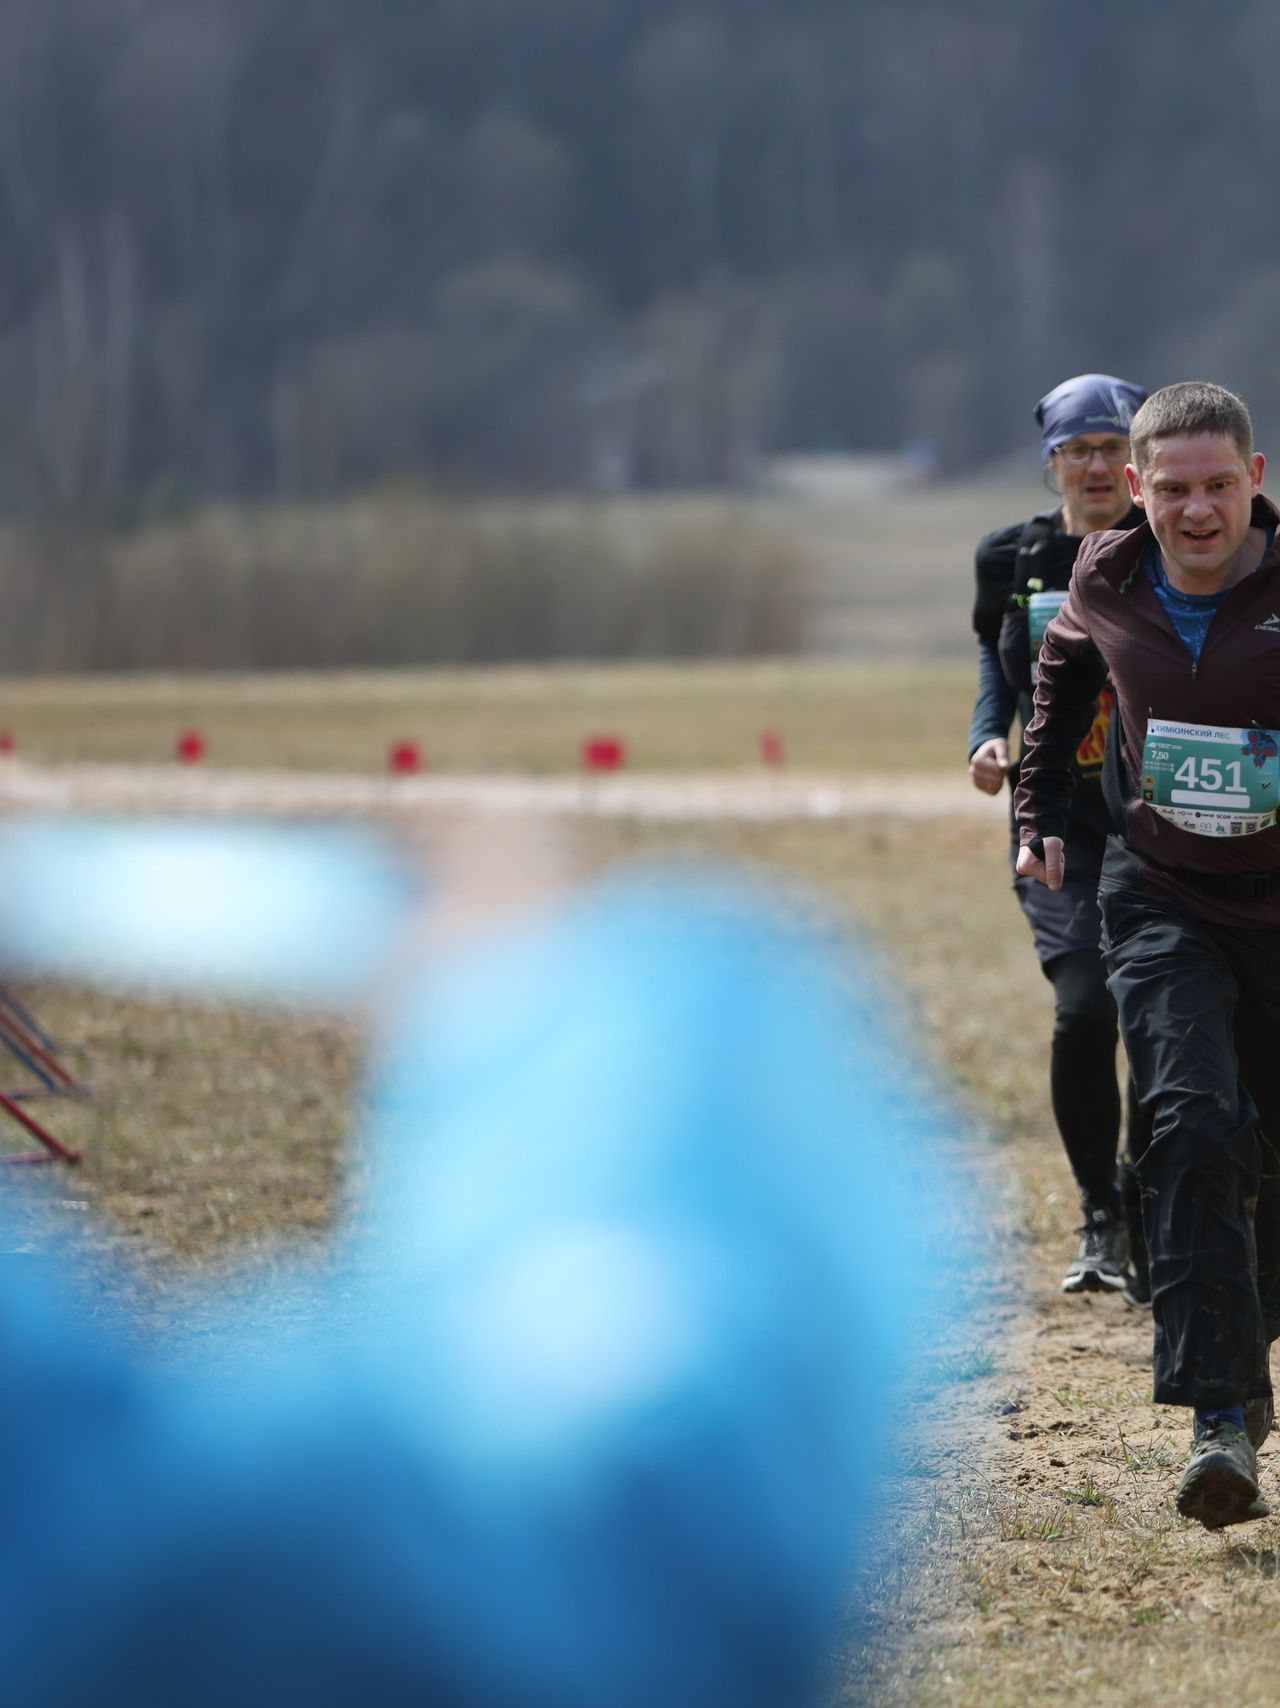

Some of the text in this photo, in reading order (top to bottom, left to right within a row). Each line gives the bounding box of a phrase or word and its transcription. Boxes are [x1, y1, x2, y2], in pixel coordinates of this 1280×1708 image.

[1155, 724, 1231, 740] ХИМКИНСКИЙ ЛЕС
[1151, 750, 1169, 760] 7,50
[1174, 756, 1248, 793] 451
